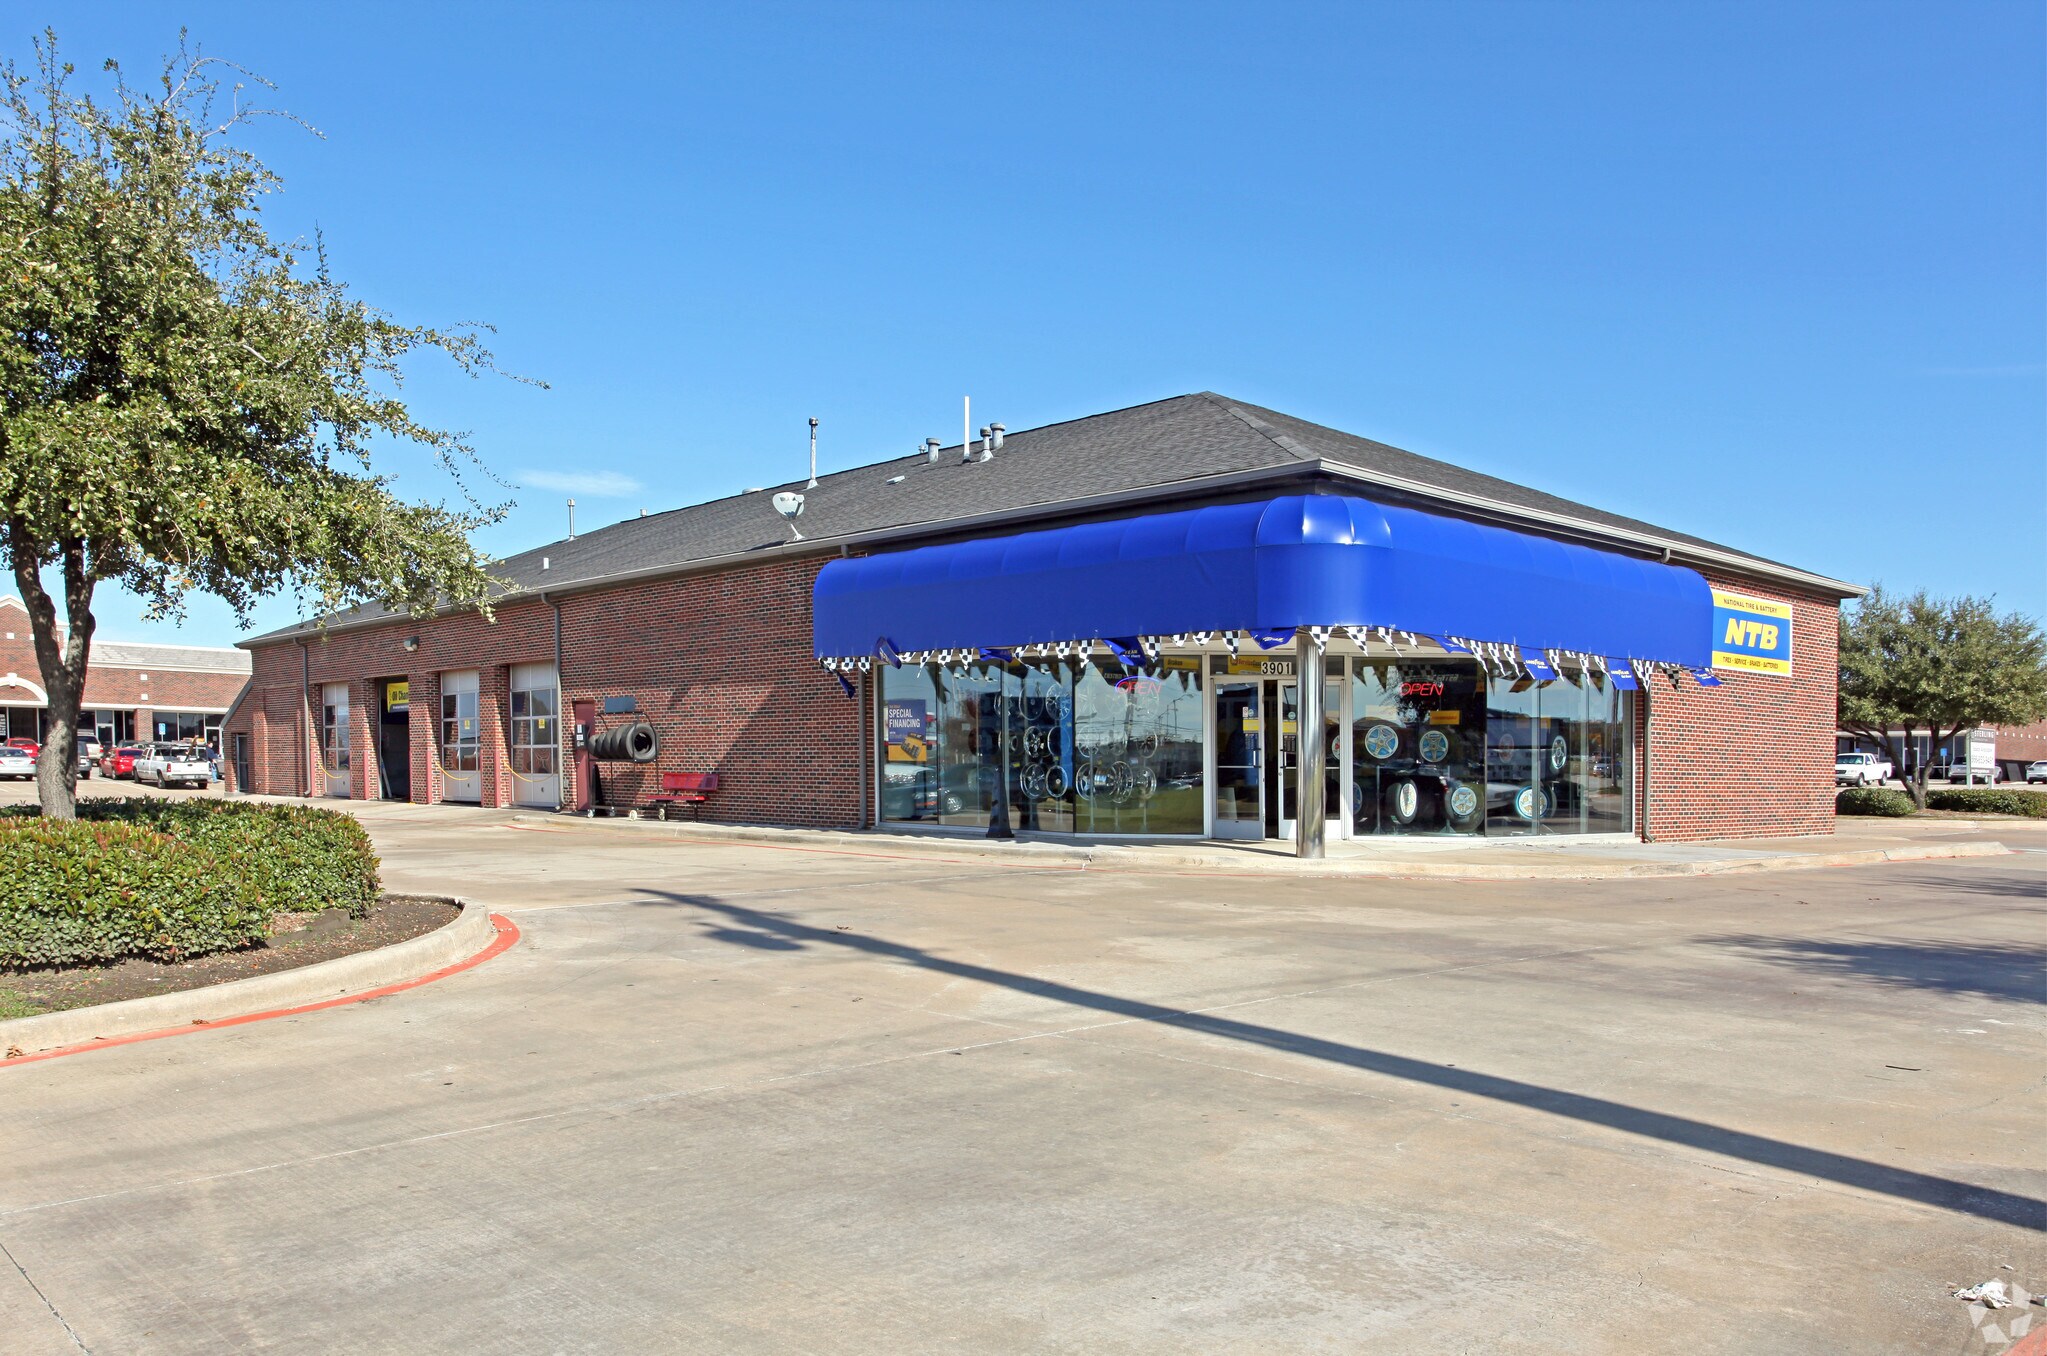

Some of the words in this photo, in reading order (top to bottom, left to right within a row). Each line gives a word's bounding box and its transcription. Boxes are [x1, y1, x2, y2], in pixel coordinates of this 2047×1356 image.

[1723, 598, 1745, 608] NATIONAL
[1759, 605, 1778, 613] BATTERY
[1724, 617, 1779, 650] NTB
[1262, 662, 1290, 675] 3901
[1117, 681, 1162, 695] OPEN
[1400, 682, 1445, 696] OPEN
[889, 708, 913, 718] SPECIAL
[889, 719, 921, 728] FINANCING
